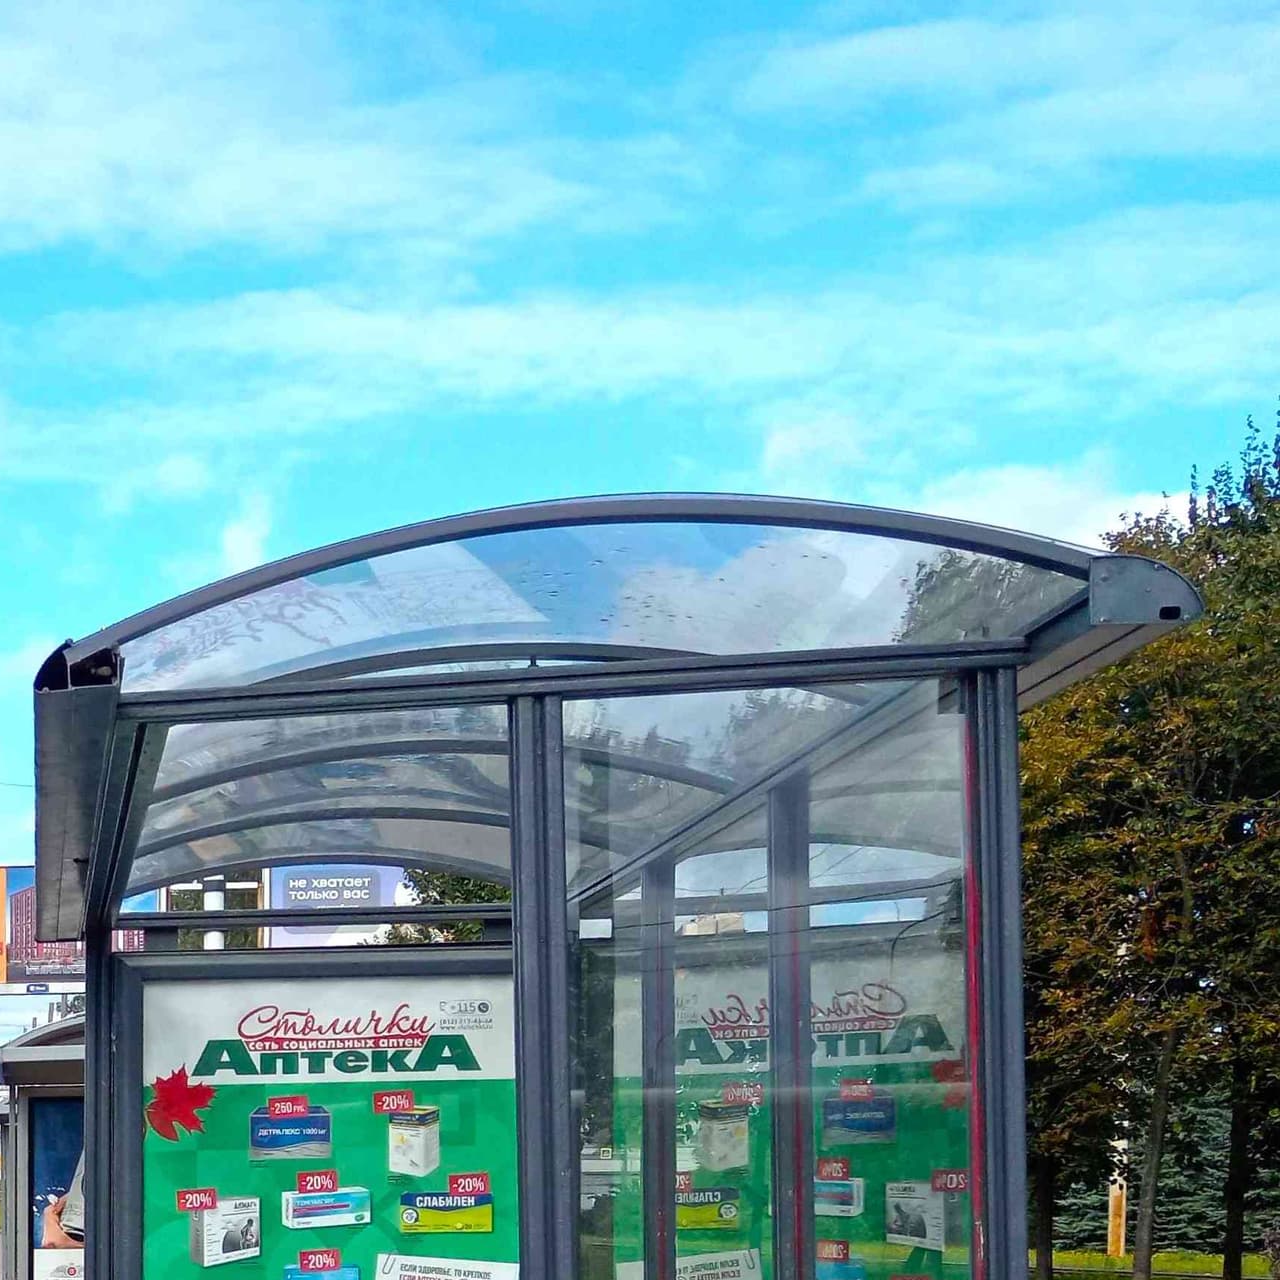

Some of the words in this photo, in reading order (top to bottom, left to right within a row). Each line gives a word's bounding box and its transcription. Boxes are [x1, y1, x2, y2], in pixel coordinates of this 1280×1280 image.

[288, 879, 308, 889] не
[311, 877, 372, 889] хватает
[288, 890, 339, 901] только
[343, 889, 370, 900] вас
[237, 1002, 436, 1040] Столички
[248, 1041, 279, 1051] сеть
[282, 1038, 376, 1050] социальных
[378, 1036, 423, 1049] аптек
[376, 1096, 410, 1110] -20%
[300, 1175, 333, 1190] -20%
[452, 1177, 485, 1193] -20%
[180, 1193, 213, 1208] -20%
[415, 1196, 475, 1208] СЛАБИЛЕН
[302, 1255, 336, 1269] -20%
